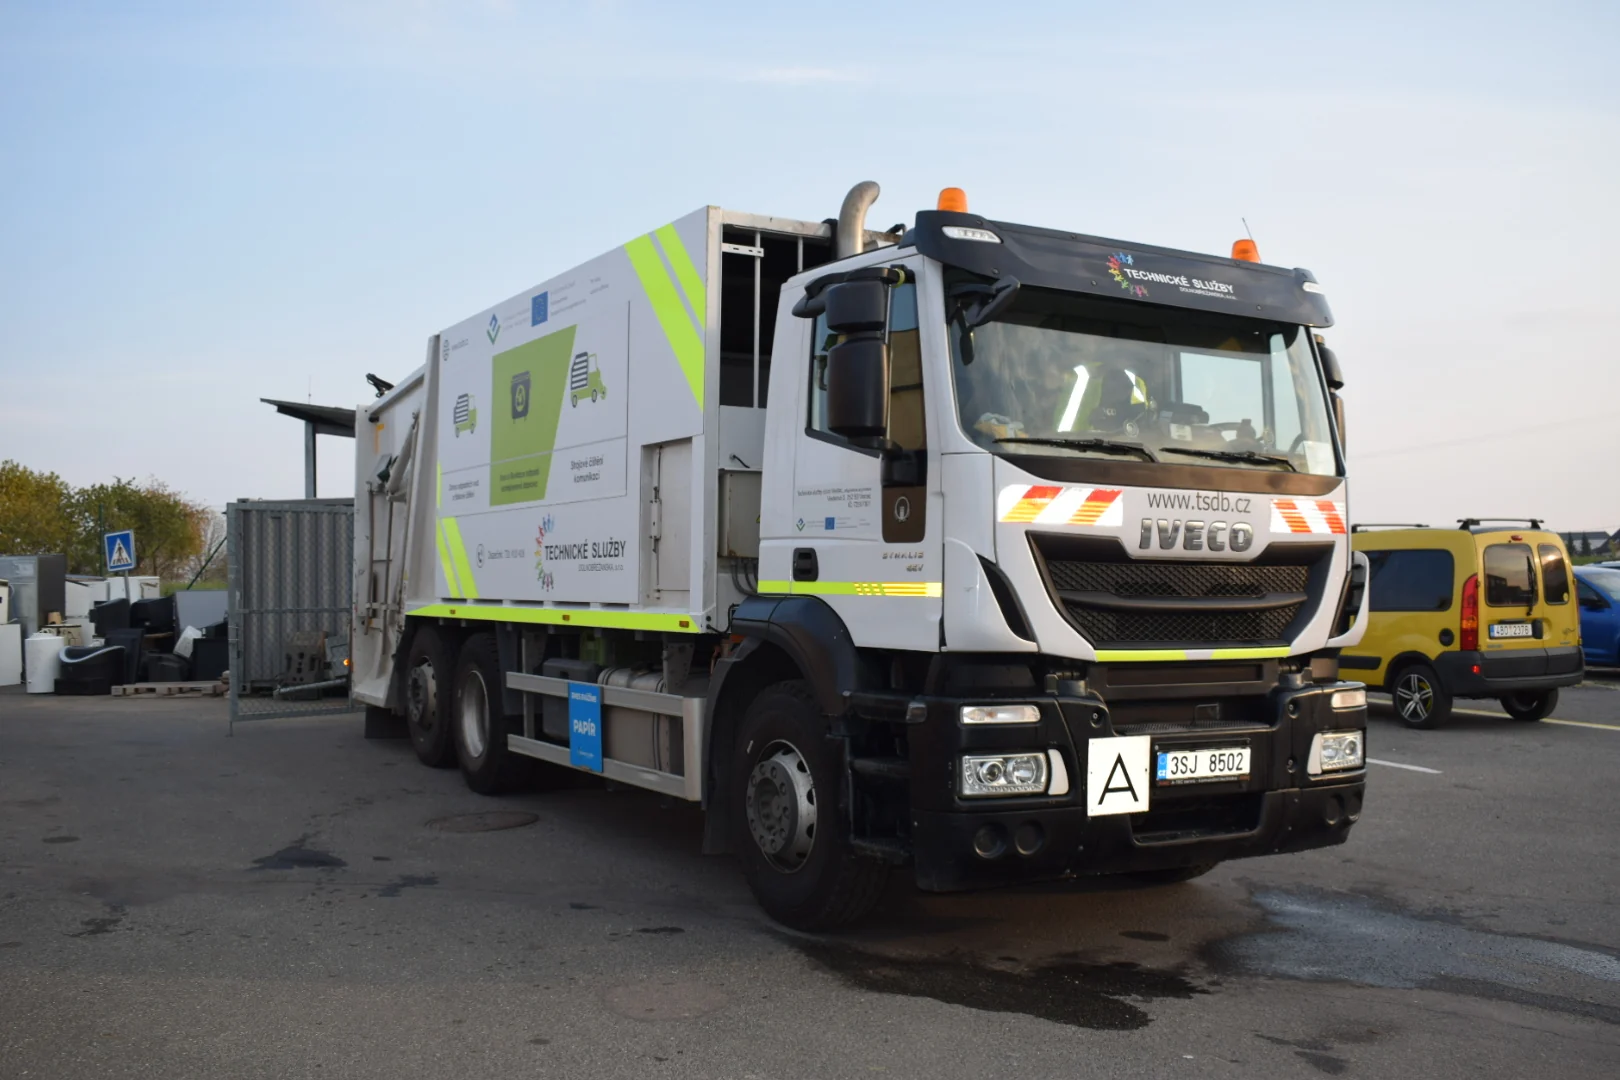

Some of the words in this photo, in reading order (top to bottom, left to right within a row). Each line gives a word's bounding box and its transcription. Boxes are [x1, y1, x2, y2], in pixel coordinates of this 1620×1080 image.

[1124, 268, 1190, 287] TECHNICKÉ
[1192, 279, 1235, 294] SLUŽBY
[1147, 491, 1252, 514] www.tsdb.cz
[1139, 517, 1254, 553] IVECO
[544, 539, 589, 561] TECHNICKÉ
[590, 537, 626, 560] SLUŽBY
[573, 718, 597, 737] PAPÍR
[1170, 754, 1198, 776] 3SJ
[1208, 751, 1244, 773] 8502
[1097, 752, 1140, 806] A
